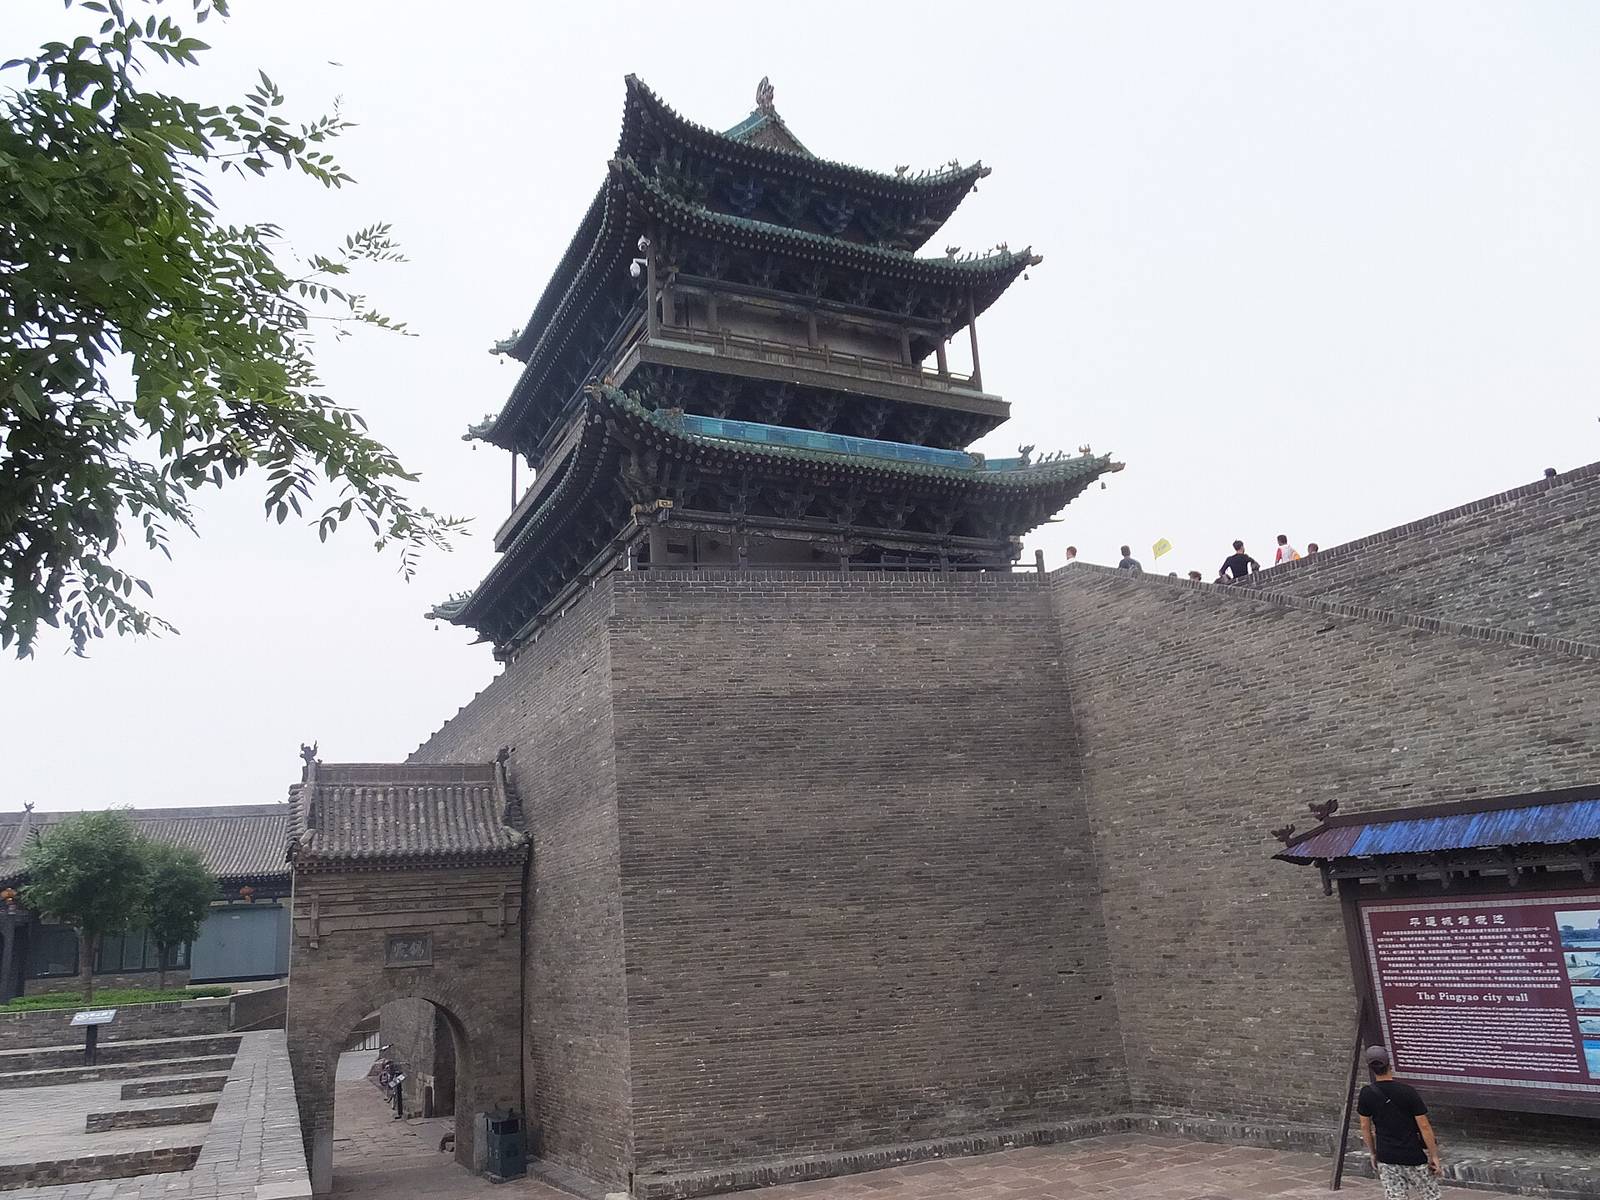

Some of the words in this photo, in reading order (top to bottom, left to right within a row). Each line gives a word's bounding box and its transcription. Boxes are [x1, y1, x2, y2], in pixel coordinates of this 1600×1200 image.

[1416, 992, 1435, 1001] The
[1438, 992, 1479, 1003] Pingyao
[1482, 993, 1503, 1004] city
[1506, 993, 1529, 1002] wall
